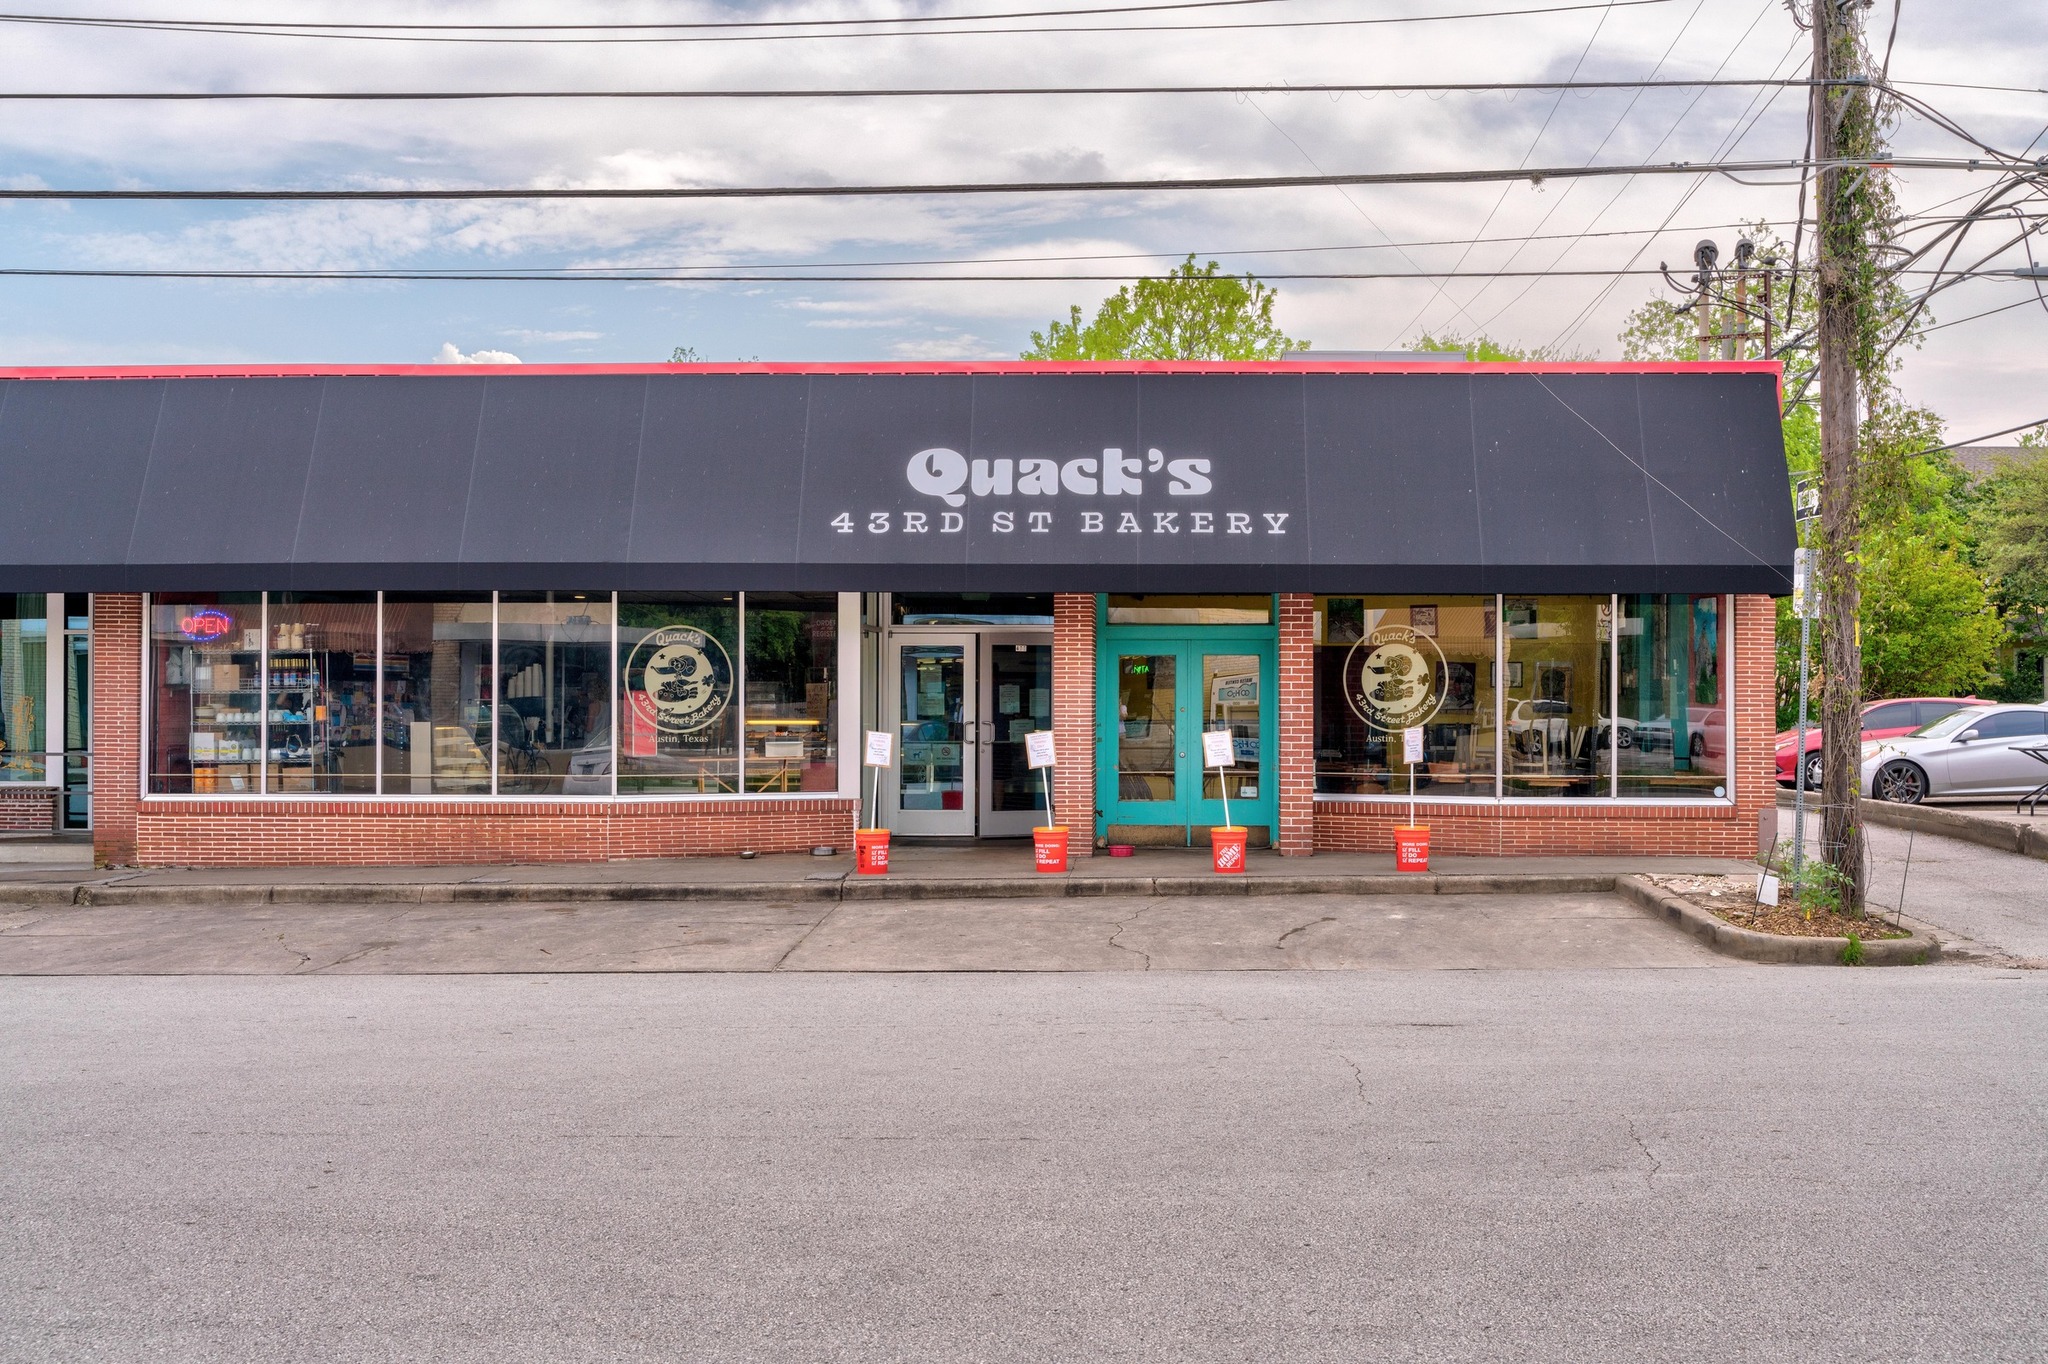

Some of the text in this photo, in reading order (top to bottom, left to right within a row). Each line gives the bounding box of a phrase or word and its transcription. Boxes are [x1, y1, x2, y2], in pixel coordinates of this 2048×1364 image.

[906, 447, 1213, 508] Quack's
[830, 512, 1289, 534] 43RD ST BAKERY
[181, 617, 229, 634] OPEN
[655, 630, 702, 646] Quack's
[1372, 629, 1416, 646] Quack's
[658, 711, 690, 725] Street
[690, 694, 722, 726] Bakery
[1355, 693, 1437, 725] 43rd Street Bakery
[648, 734, 709, 744] Austin, Texas
[1217, 843, 1241, 868] HOME
